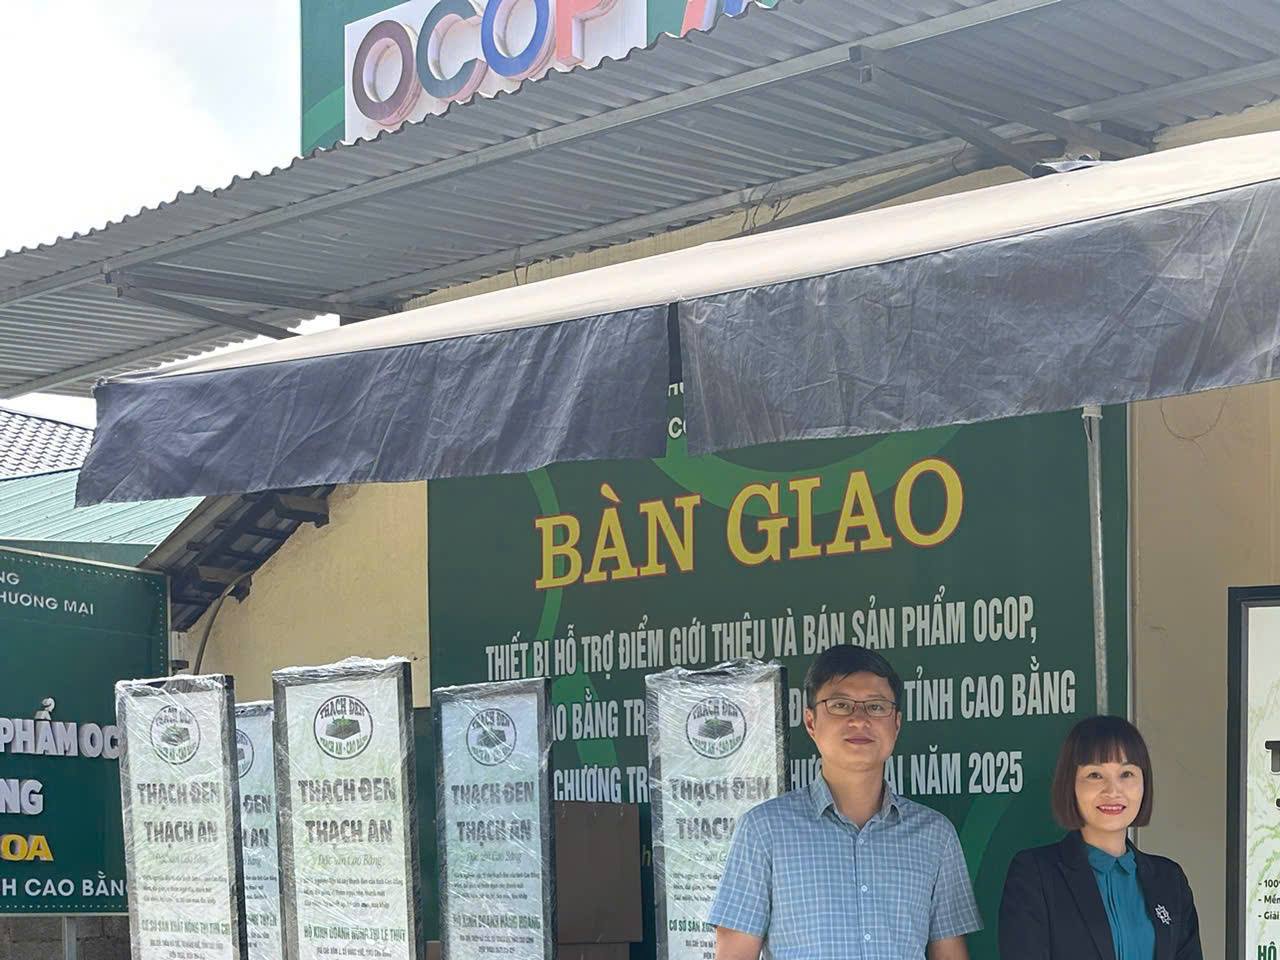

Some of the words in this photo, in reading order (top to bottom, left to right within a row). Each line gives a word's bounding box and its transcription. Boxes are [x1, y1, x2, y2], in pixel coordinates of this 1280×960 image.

[352, 0, 617, 122] OCOP
[534, 483, 701, 590] BÀN
[726, 457, 964, 567] GIAO
[64, 600, 94, 617] MẠI
[485, 630, 529, 681] THIẾT
[554, 622, 577, 676] HỖ
[581, 631, 614, 680] TRỢ
[617, 614, 665, 670] ĐIỂM
[669, 616, 706, 666] GIỚI
[771, 607, 798, 658] VÀ
[802, 604, 845, 655] BÁN
[851, 594, 896, 650] SẢN
[901, 585, 967, 647] PHẨM
[973, 594, 1038, 644] OCOP,
[571, 688, 619, 741] BẰNG
[903, 665, 954, 722] TỈNH
[960, 674, 1005, 720] CAO
[1011, 655, 1076, 717] BẰNG
[0, 697, 79, 756] PHẨM
[553, 763, 623, 804] CHƯƠNG
[910, 744, 962, 796] NĂM
[967, 750, 1024, 795] 2025
[137, 781, 189, 811] THẠCH
[189, 780, 220, 805] ĐEN
[297, 777, 356, 808] THẠCH
[358, 776, 397, 802] ĐEN
[669, 779, 729, 807] THẠCH
[143, 820, 194, 849] THẠCH
[197, 820, 219, 843] AN
[305, 819, 363, 849] THẠCH
[367, 819, 393, 843] AN
[456, 820, 506, 847] THẠCH
[25, 879, 75, 897] CAO
[1264, 911, 1280, 920] Giải
